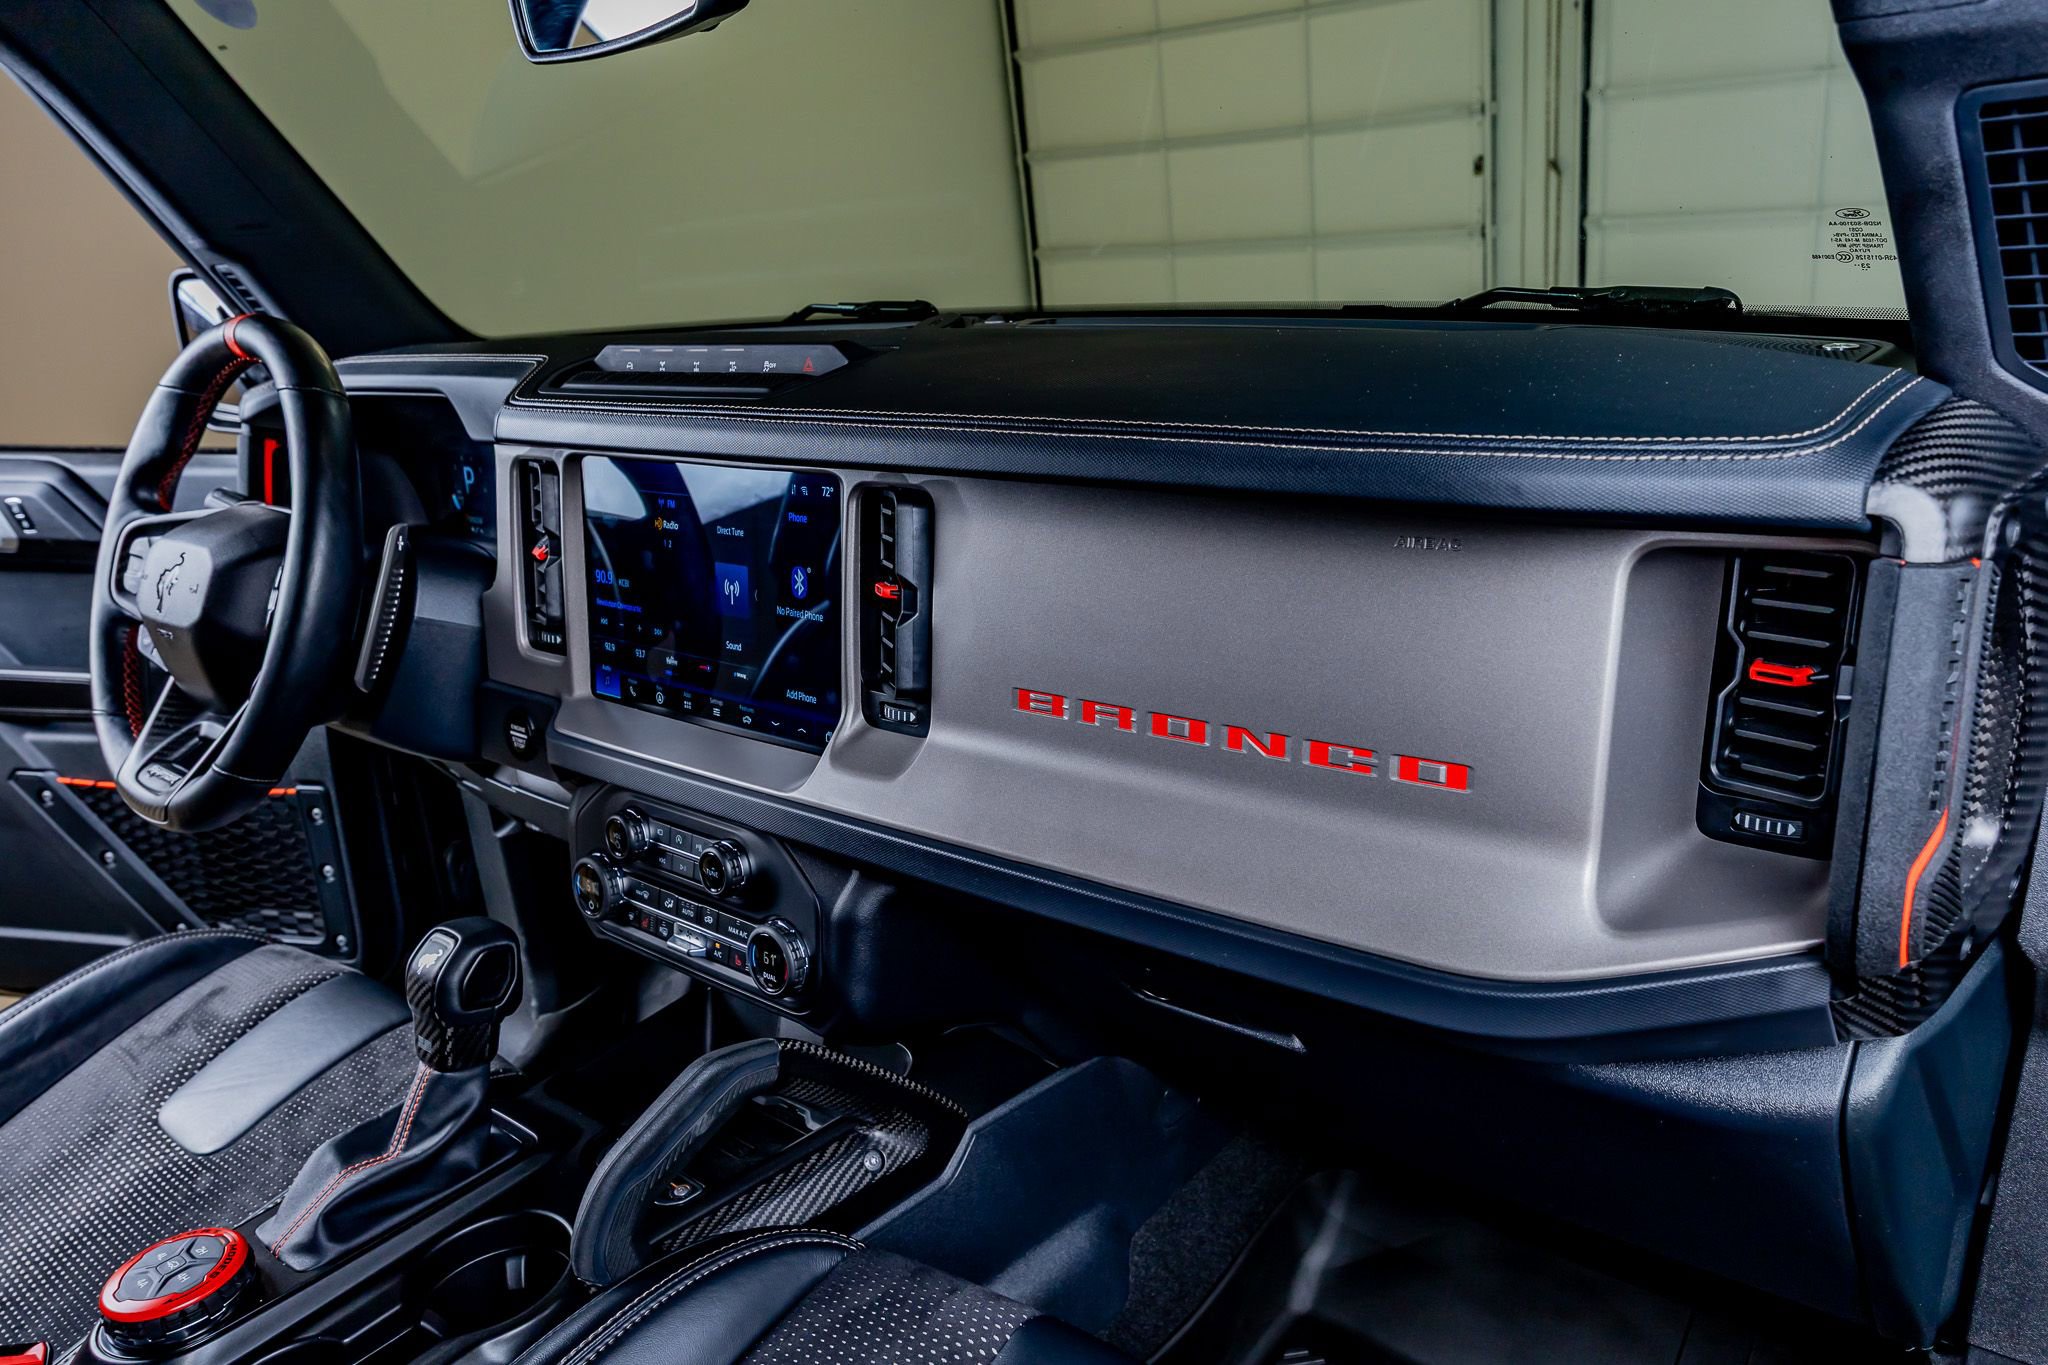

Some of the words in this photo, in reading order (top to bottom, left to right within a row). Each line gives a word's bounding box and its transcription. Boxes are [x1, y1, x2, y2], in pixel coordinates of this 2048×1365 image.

[788, 512, 808, 523] Phone
[663, 520, 679, 530] Radio
[716, 525, 731, 536] Direct
[732, 527, 744, 537] Tune
[595, 569, 613, 584] 90.9
[776, 605, 786, 616] No
[786, 607, 804, 619] Paired
[804, 610, 824, 622] Phone
[725, 640, 742, 652] Sound
[786, 689, 798, 700] Add
[799, 692, 817, 704] Phone
[1012, 687, 1474, 794] BRONCO
[681, 907, 694, 918] AUTO
[728, 926, 739, 935] MAX
[713, 950, 722, 959] A/C
